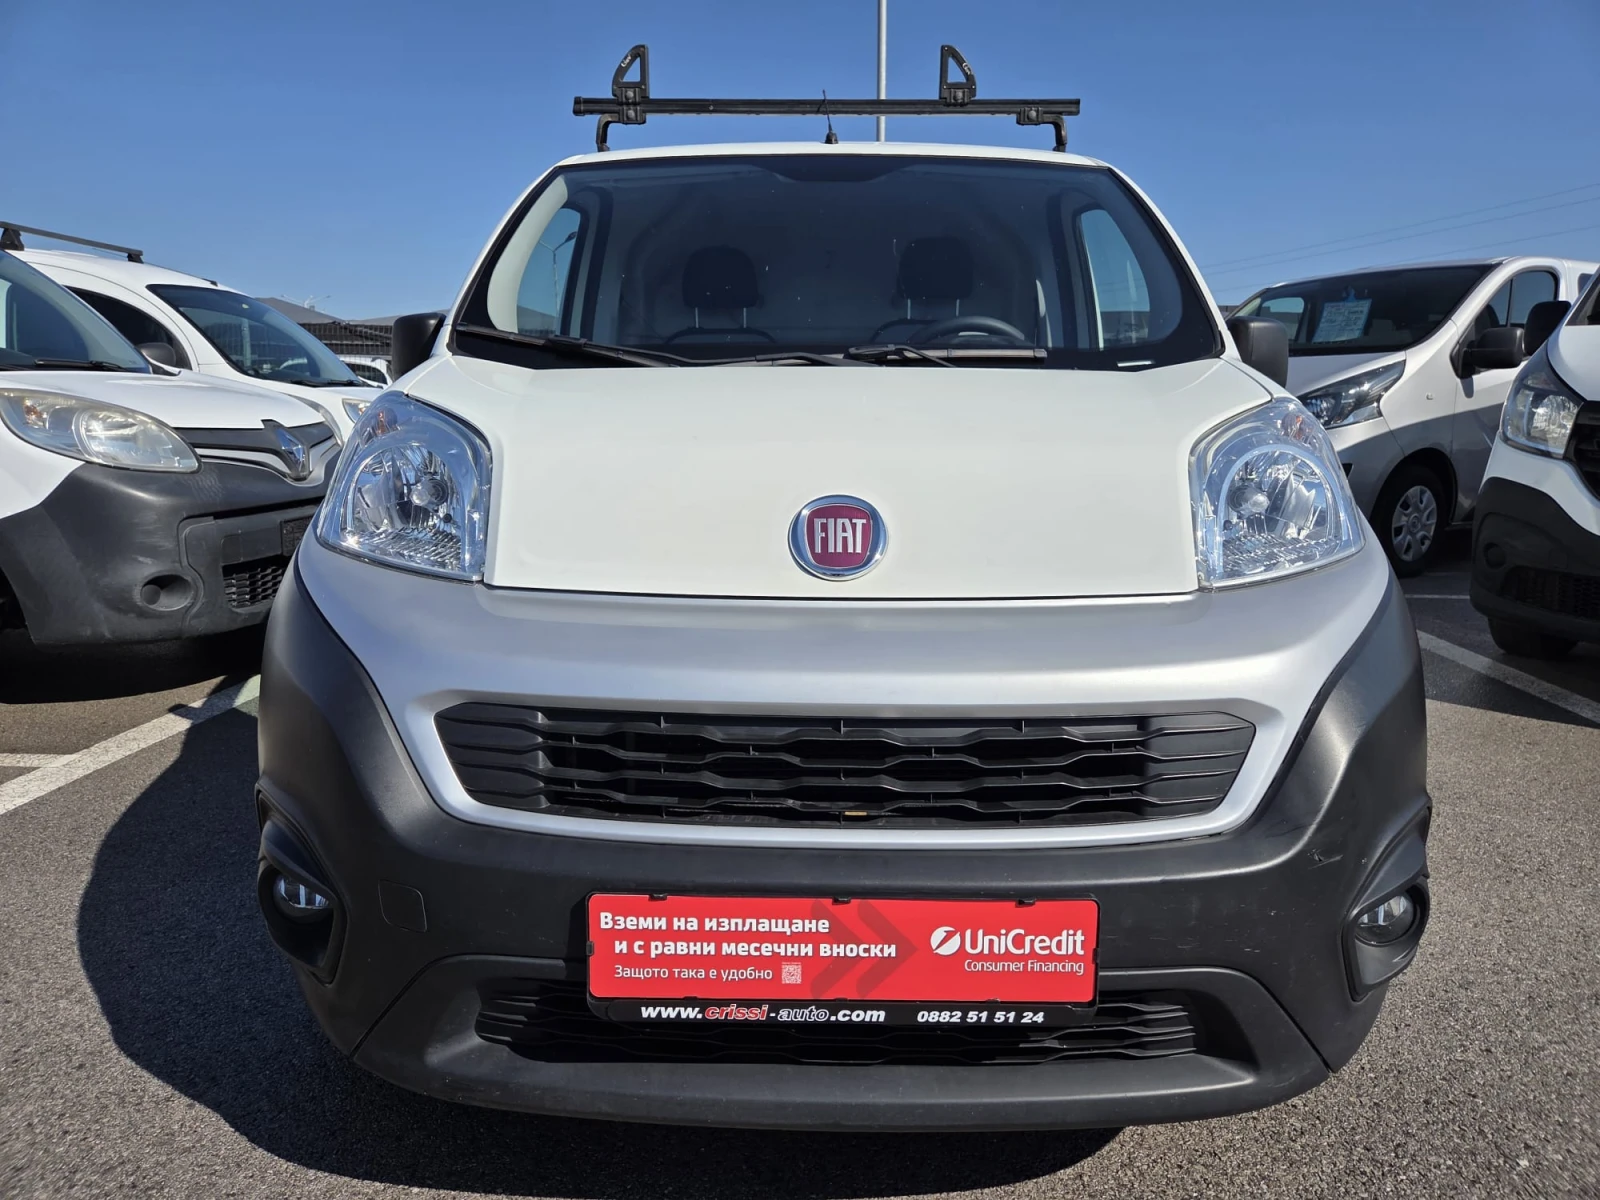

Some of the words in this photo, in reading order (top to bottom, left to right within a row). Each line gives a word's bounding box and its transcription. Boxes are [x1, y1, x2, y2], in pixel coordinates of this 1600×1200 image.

[813, 517, 867, 554] FIAT
[600, 912, 667, 931] Вземи
[673, 917, 698, 931] на
[704, 917, 830, 935] изплащане
[614, 940, 628, 954] и
[633, 940, 645, 954] с
[650, 941, 716, 958] равни
[721, 942, 813, 957] месечни
[819, 943, 896, 957] вноски
[965, 928, 1085, 956] UniCredit
[614, 965, 669, 979] Защото
[672, 967, 705, 979] така
[709, 967, 717, 979] е
[721, 965, 773, 982] удобно
[964, 959, 1025, 972] Consumer
[1028, 959, 1084, 975] Financing
[641, 1004, 886, 1022] www.crissi-auto.com
[917, 1010, 961, 1023] 0882
[966, 1011, 988, 1023] 51
[994, 1011, 1016, 1023] 51
[1021, 1011, 1044, 1024] 24
